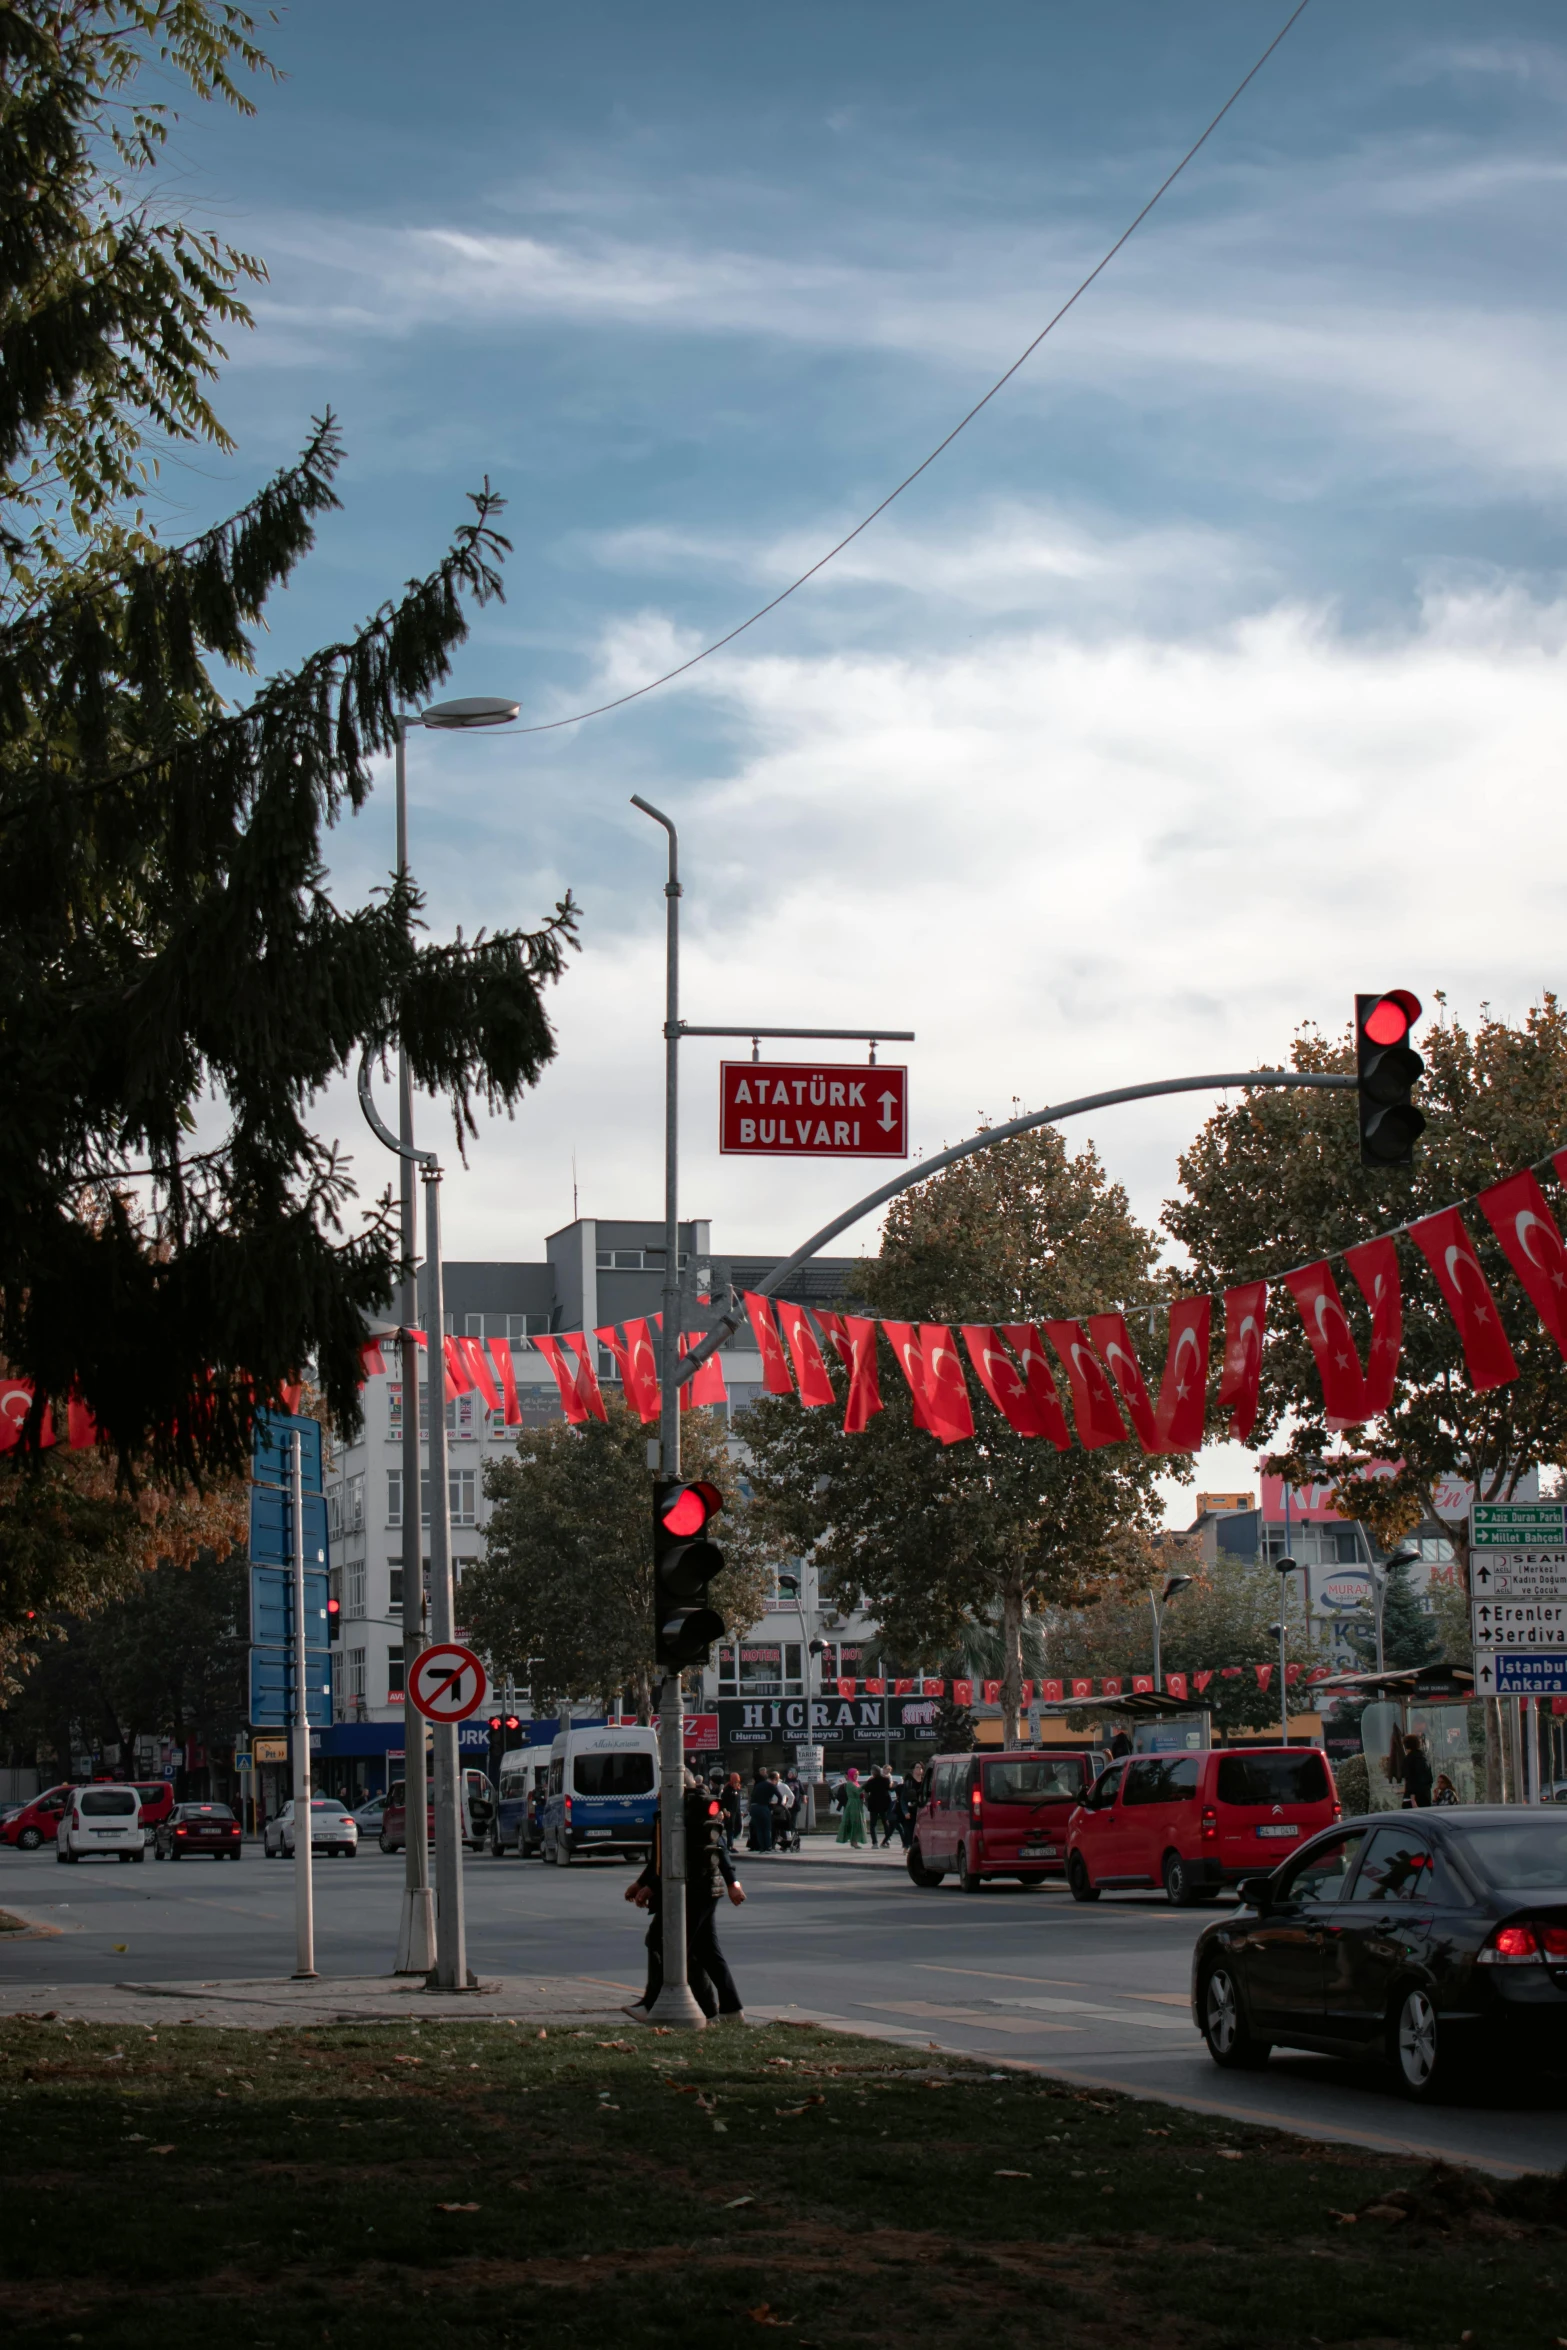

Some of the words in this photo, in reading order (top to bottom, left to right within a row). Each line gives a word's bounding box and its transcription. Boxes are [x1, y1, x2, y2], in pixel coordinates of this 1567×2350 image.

[734, 1074, 867, 1107] ATATÜRK
[740, 1118, 861, 1146] BULVARI
[1491, 1512, 1508, 1522] Aziz
[1512, 1511, 1536, 1522] Duran
[1539, 1511, 1562, 1522] Parkı
[1491, 1532, 1520, 1543] Millet
[1525, 1532, 1562, 1545] Bahçesi
[1513, 1554, 1566, 1563] SEAH
[1513, 1575, 1537, 1584] Kadın
[1540, 1575, 1567, 1585] Doğum
[1328, 1584, 1370, 1595] MURAT
[1494, 1605, 1562, 1621] Erenler
[1495, 1627, 1565, 1642] Serdiva
[741, 1649, 781, 1662] NOTER
[841, 1647, 862, 1661] NOT
[1500, 1677, 1562, 1691] Ankara
[390, 1693, 406, 1701] AVU
[743, 1700, 881, 1727] HİCRAN
[736, 1732, 767, 1741] Hurma
[787, 1731, 839, 1741] Kurumeyve
[588, 1739, 613, 1750] Allah
[165, 1765, 174, 1775] D
